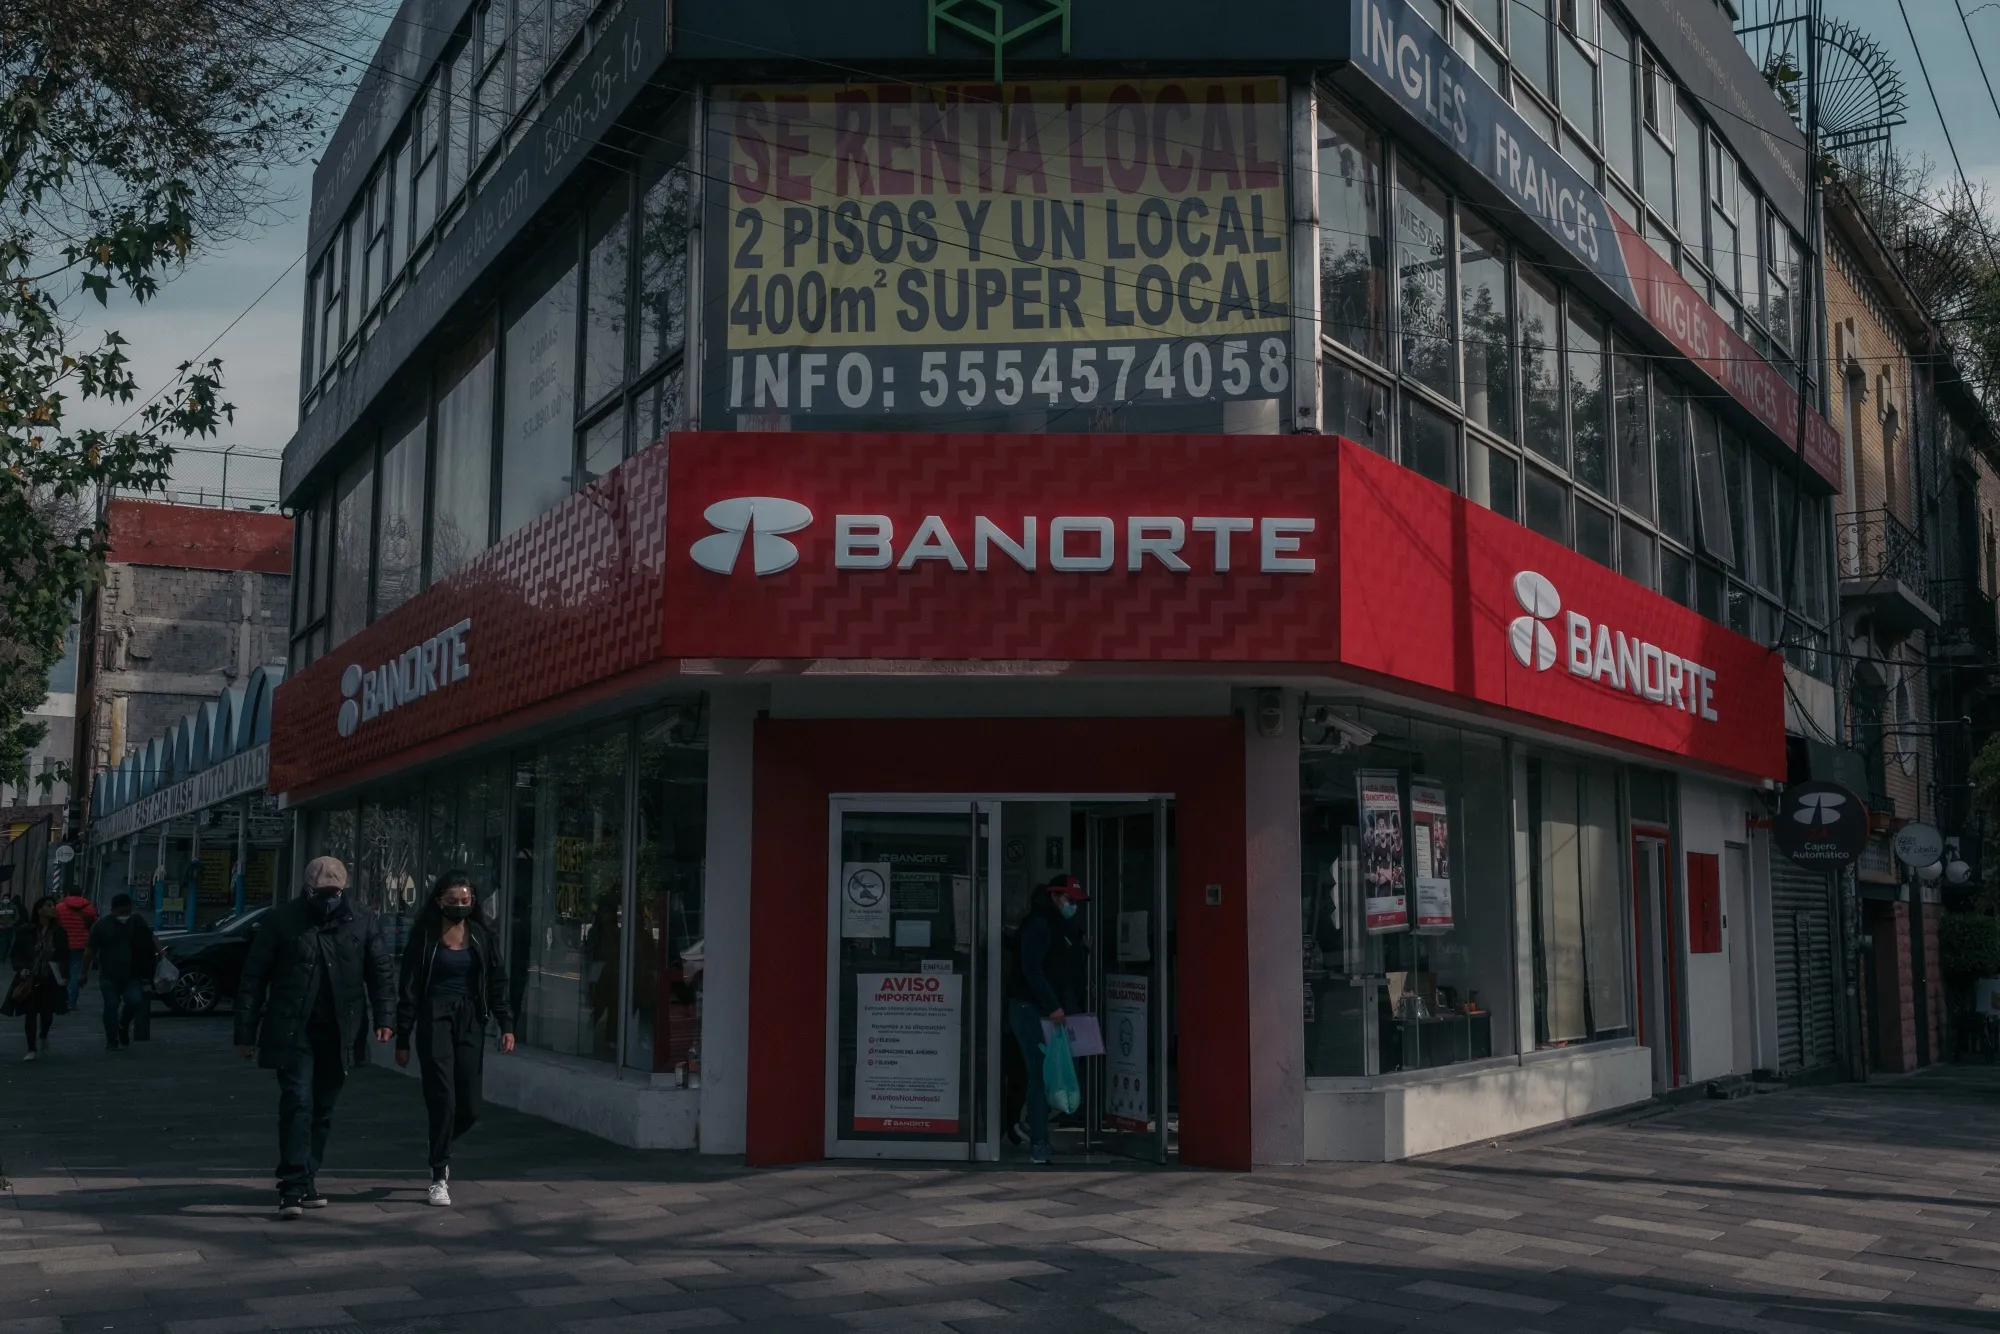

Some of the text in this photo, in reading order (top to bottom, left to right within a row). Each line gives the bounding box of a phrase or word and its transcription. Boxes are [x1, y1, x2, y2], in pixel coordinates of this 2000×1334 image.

[544, 17, 642, 176] 5208-35-16
[734, 83, 1280, 204] SE RENTA LOCAL
[1362, 0, 1599, 266] INGLÉS FRANCÉS
[735, 195, 1282, 270] 2 PISOS Y UN LOCAL
[1400, 204, 1443, 256] MESAS
[896, 267, 1083, 333] SUPER
[1104, 259, 1289, 327] LOCAL
[1401, 247, 1443, 297] DESDE
[730, 337, 1289, 409] INFO: 5554574058
[1654, 275, 1709, 359] INGLÉS
[1718, 340, 1777, 427] FRANCÉS
[835, 513, 1317, 574] BANORTE
[362, 617, 471, 723] BANORTE
[1567, 610, 1718, 723] BANORTE
[170, 779, 194, 815] WASH
[199, 748, 270, 807] AUTOLAVAD
[890, 854, 948, 863] BANORTE
[1792, 849, 1850, 860] Automático
[1804, 842, 1837, 852] Cajero
[875, 994, 944, 1002] IMPORTANTE
[880, 977, 940, 991] AVISO
